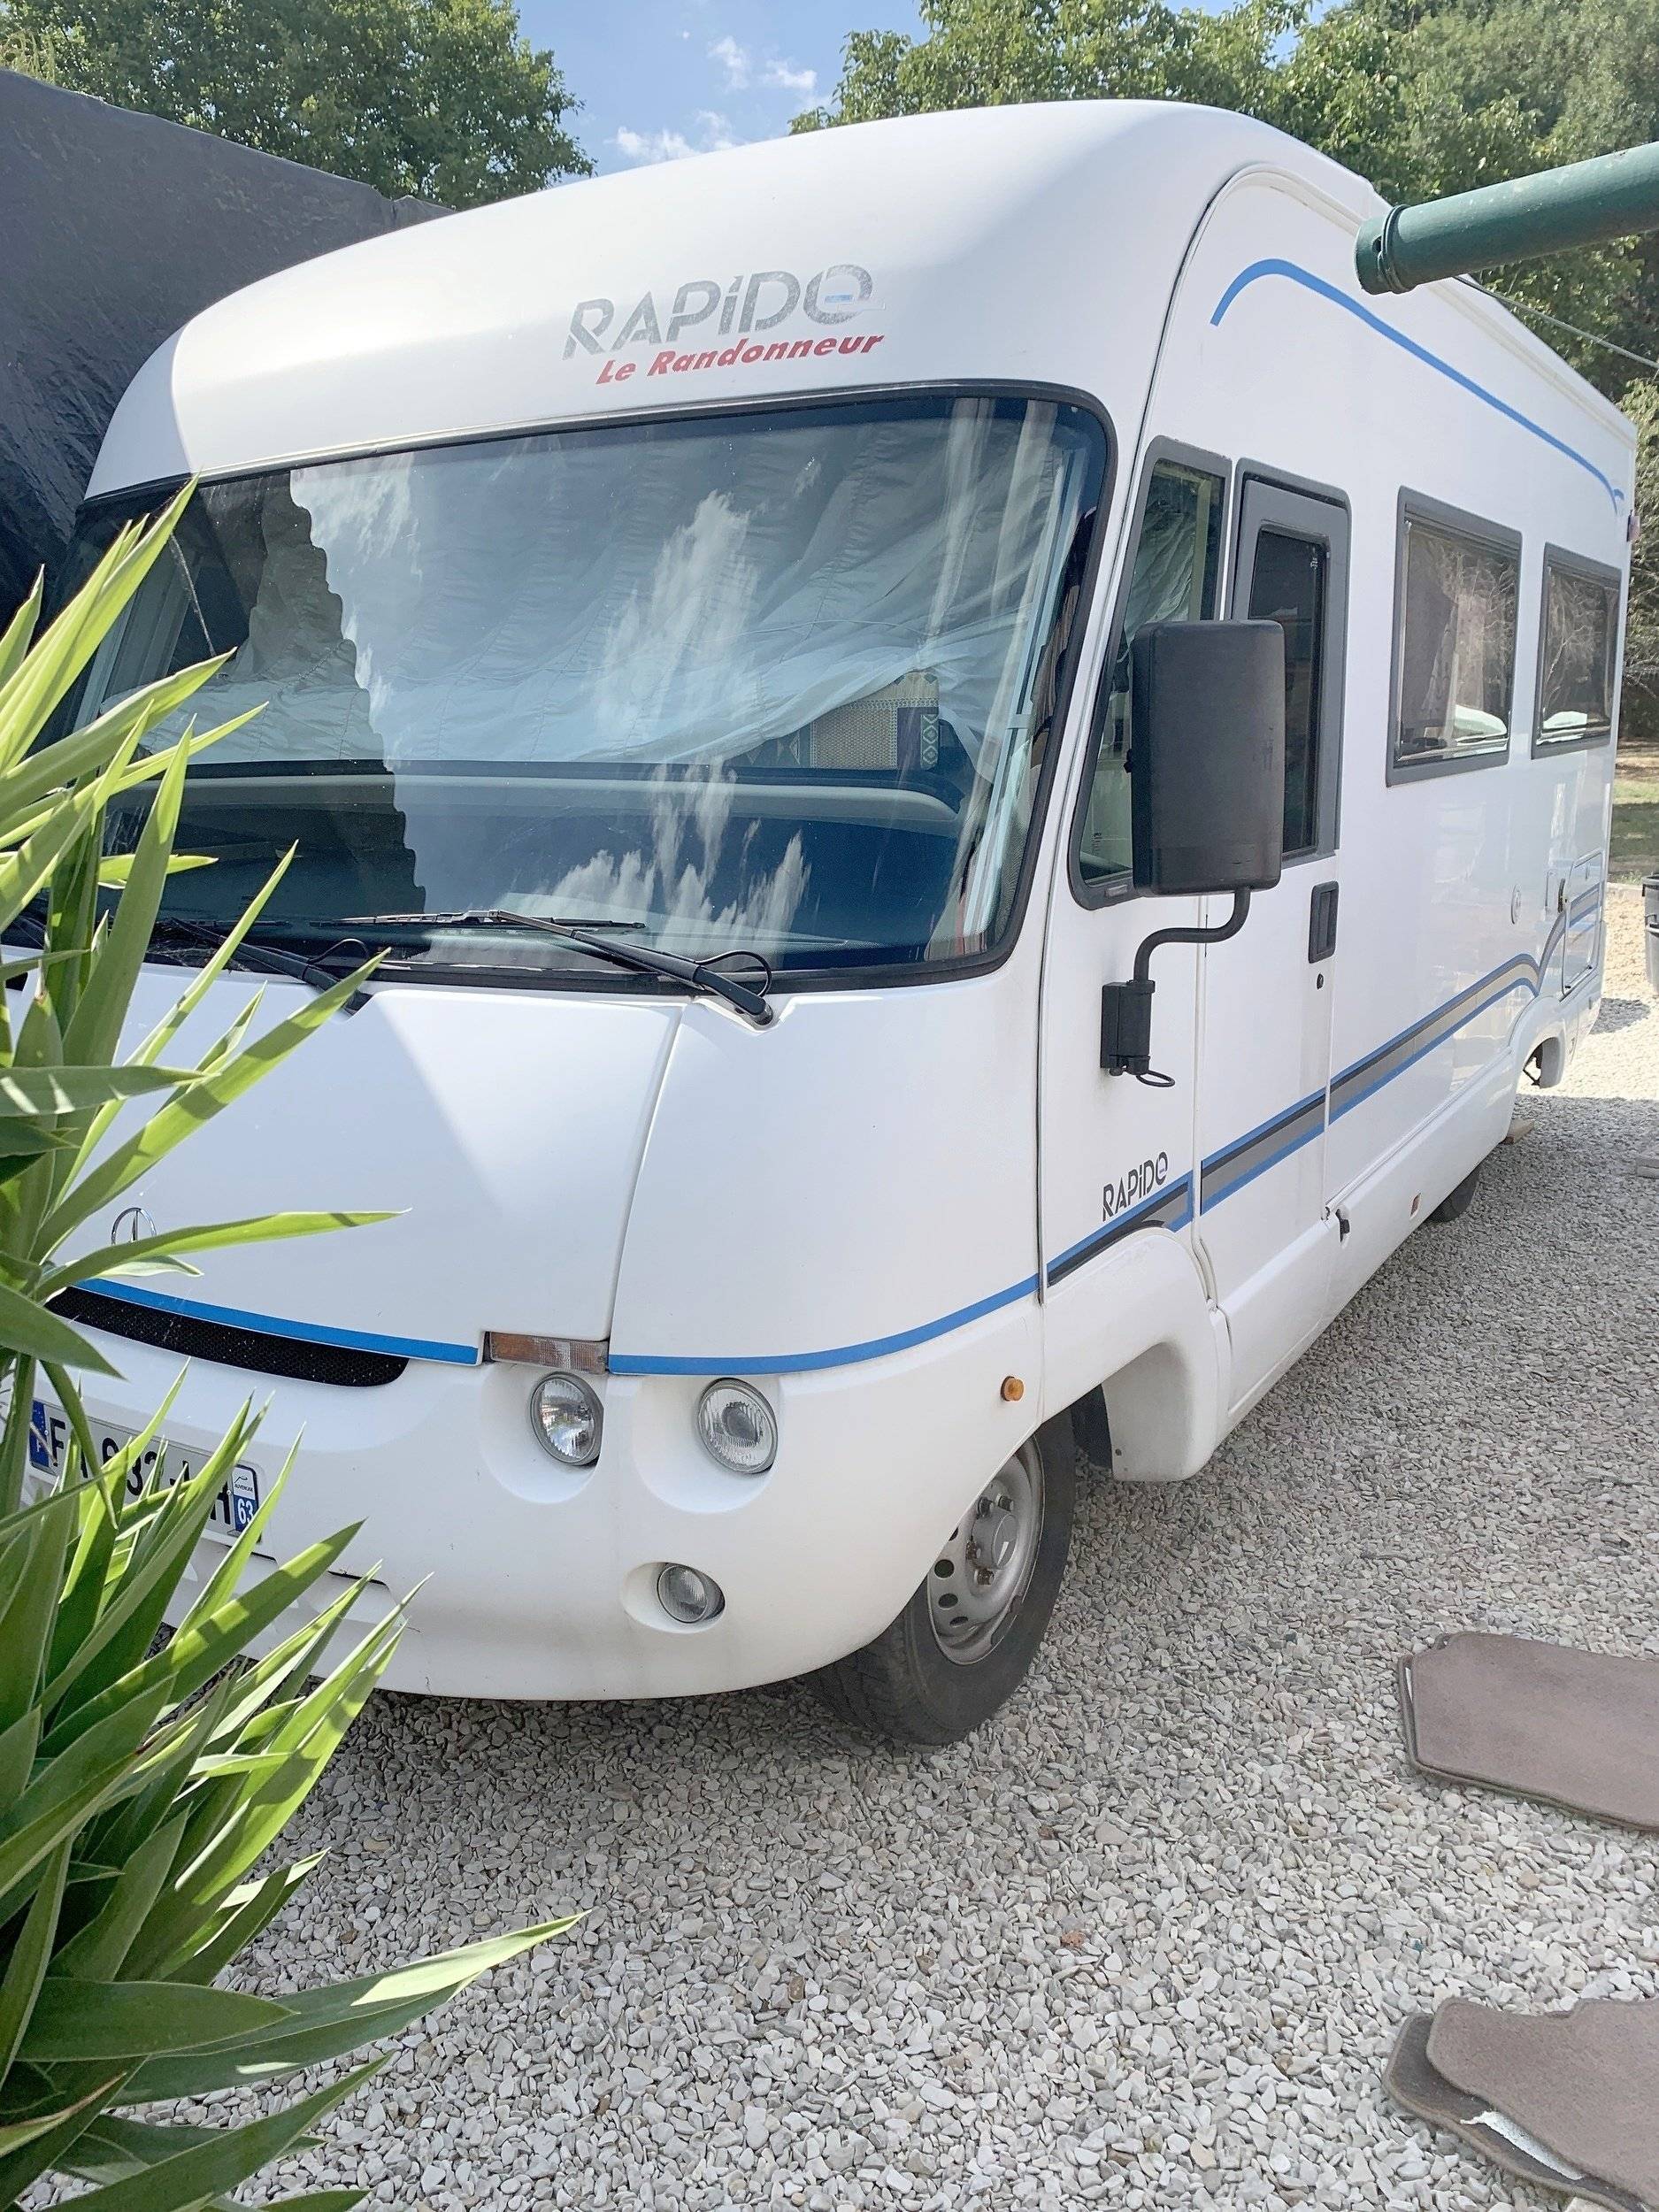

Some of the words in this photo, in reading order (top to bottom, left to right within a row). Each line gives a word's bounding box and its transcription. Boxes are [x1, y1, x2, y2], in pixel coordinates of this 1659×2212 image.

[595, 359, 636, 385] Le
[647, 333, 885, 377] Randonneur
[237, 1498, 254, 1525] 63
